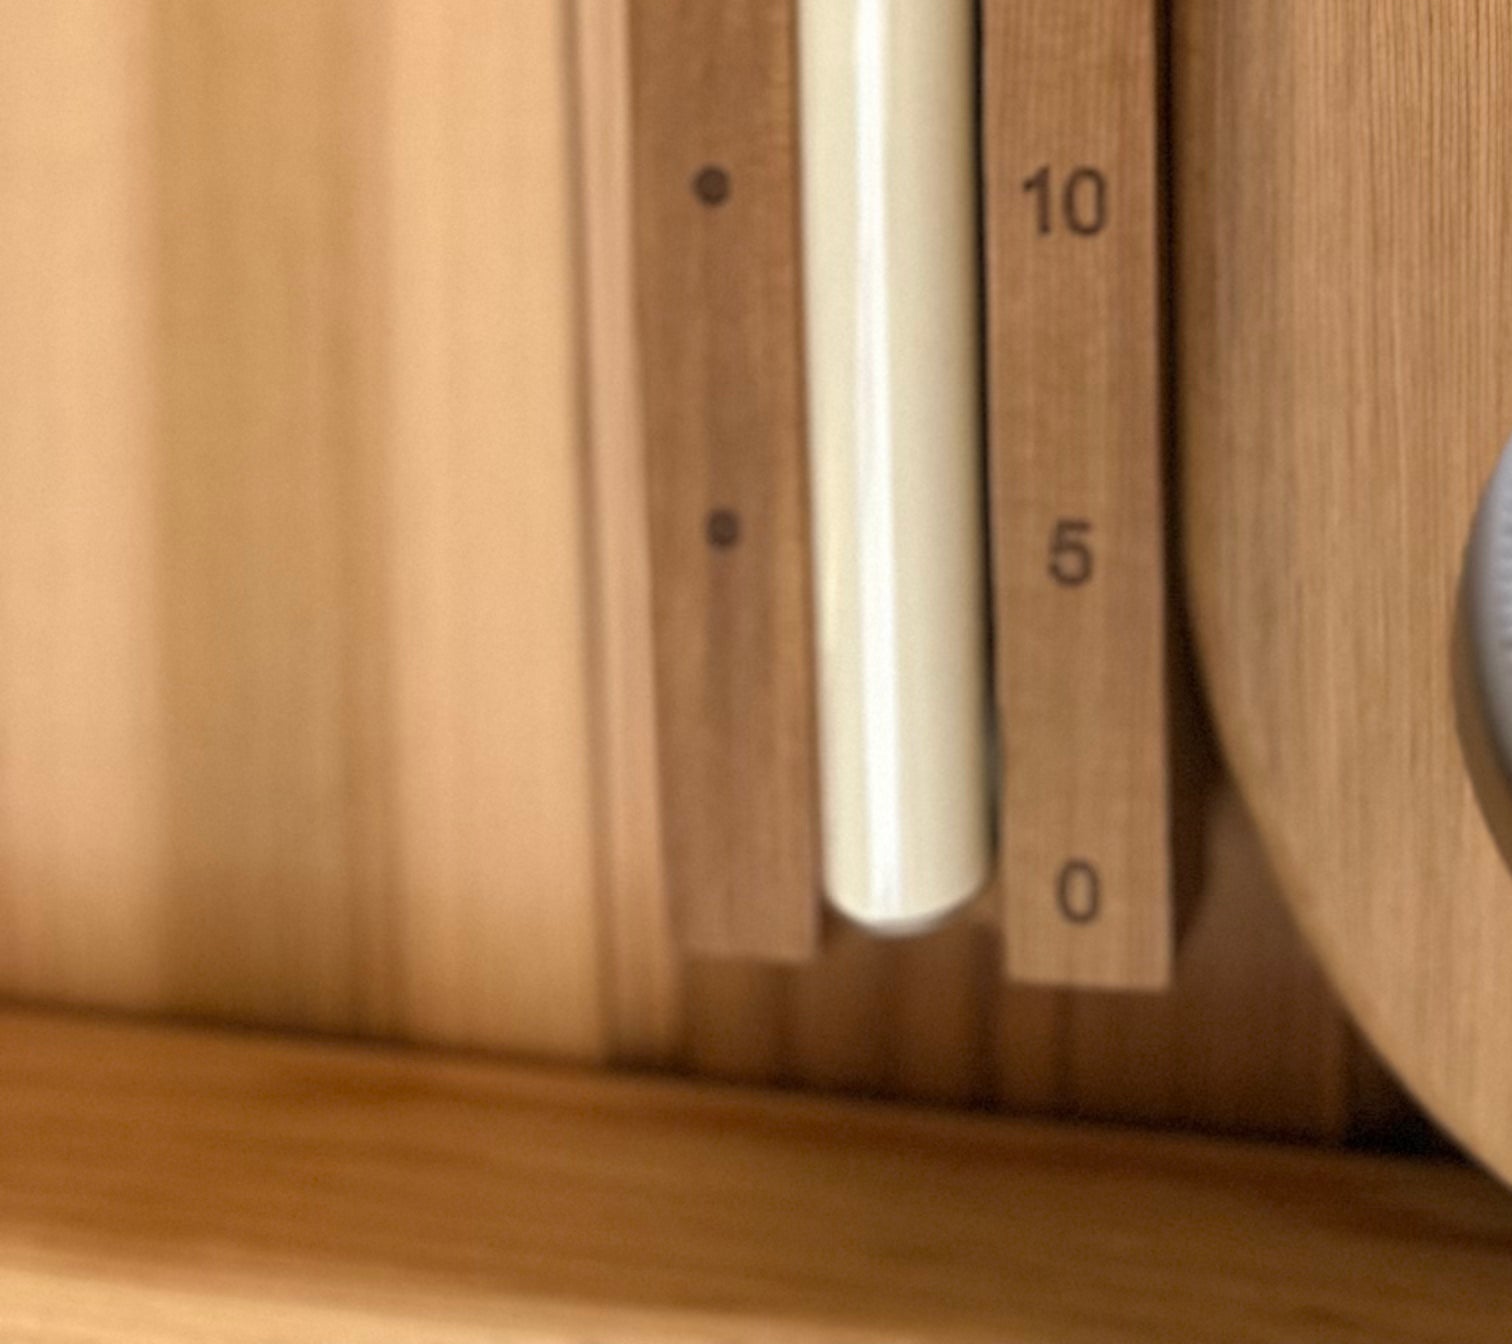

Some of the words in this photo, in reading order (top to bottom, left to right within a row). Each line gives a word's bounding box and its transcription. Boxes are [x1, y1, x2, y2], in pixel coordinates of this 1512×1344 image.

[1022, 166, 1108, 236] 10
[1049, 520, 1093, 586] 5
[1057, 860, 1100, 924] 0
